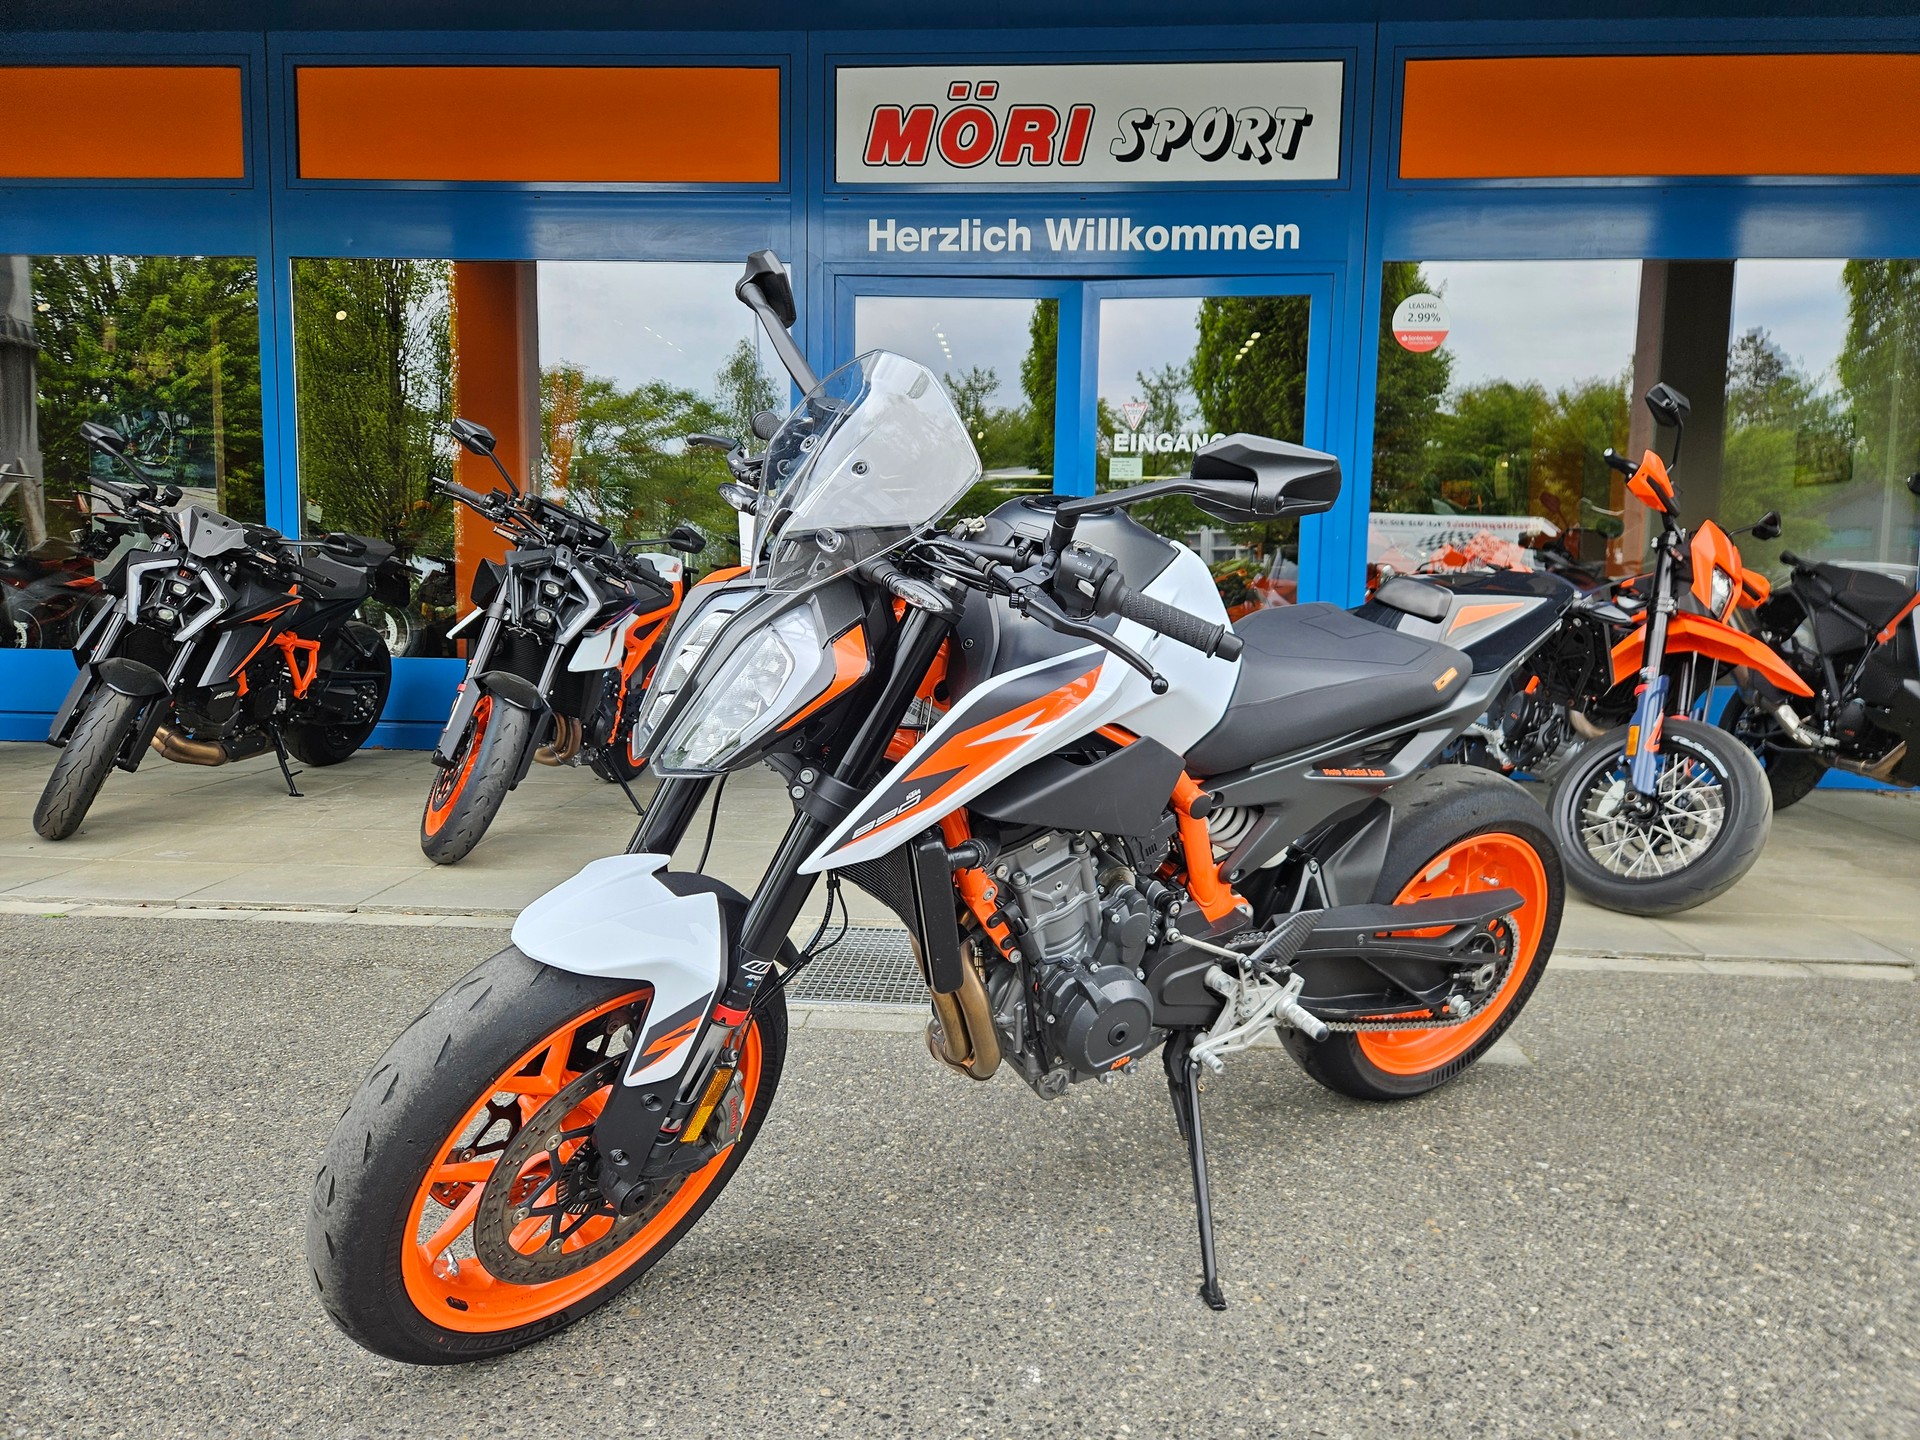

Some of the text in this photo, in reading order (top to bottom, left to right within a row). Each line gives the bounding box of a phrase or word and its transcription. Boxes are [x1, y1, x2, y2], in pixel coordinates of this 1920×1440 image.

[862, 80, 1314, 168] MÖRI SPORT
[867, 217, 1301, 253] Herzlich Willkommen
[1407, 312, 1440, 322] 2.99%
[851, 794, 921, 840] 890
